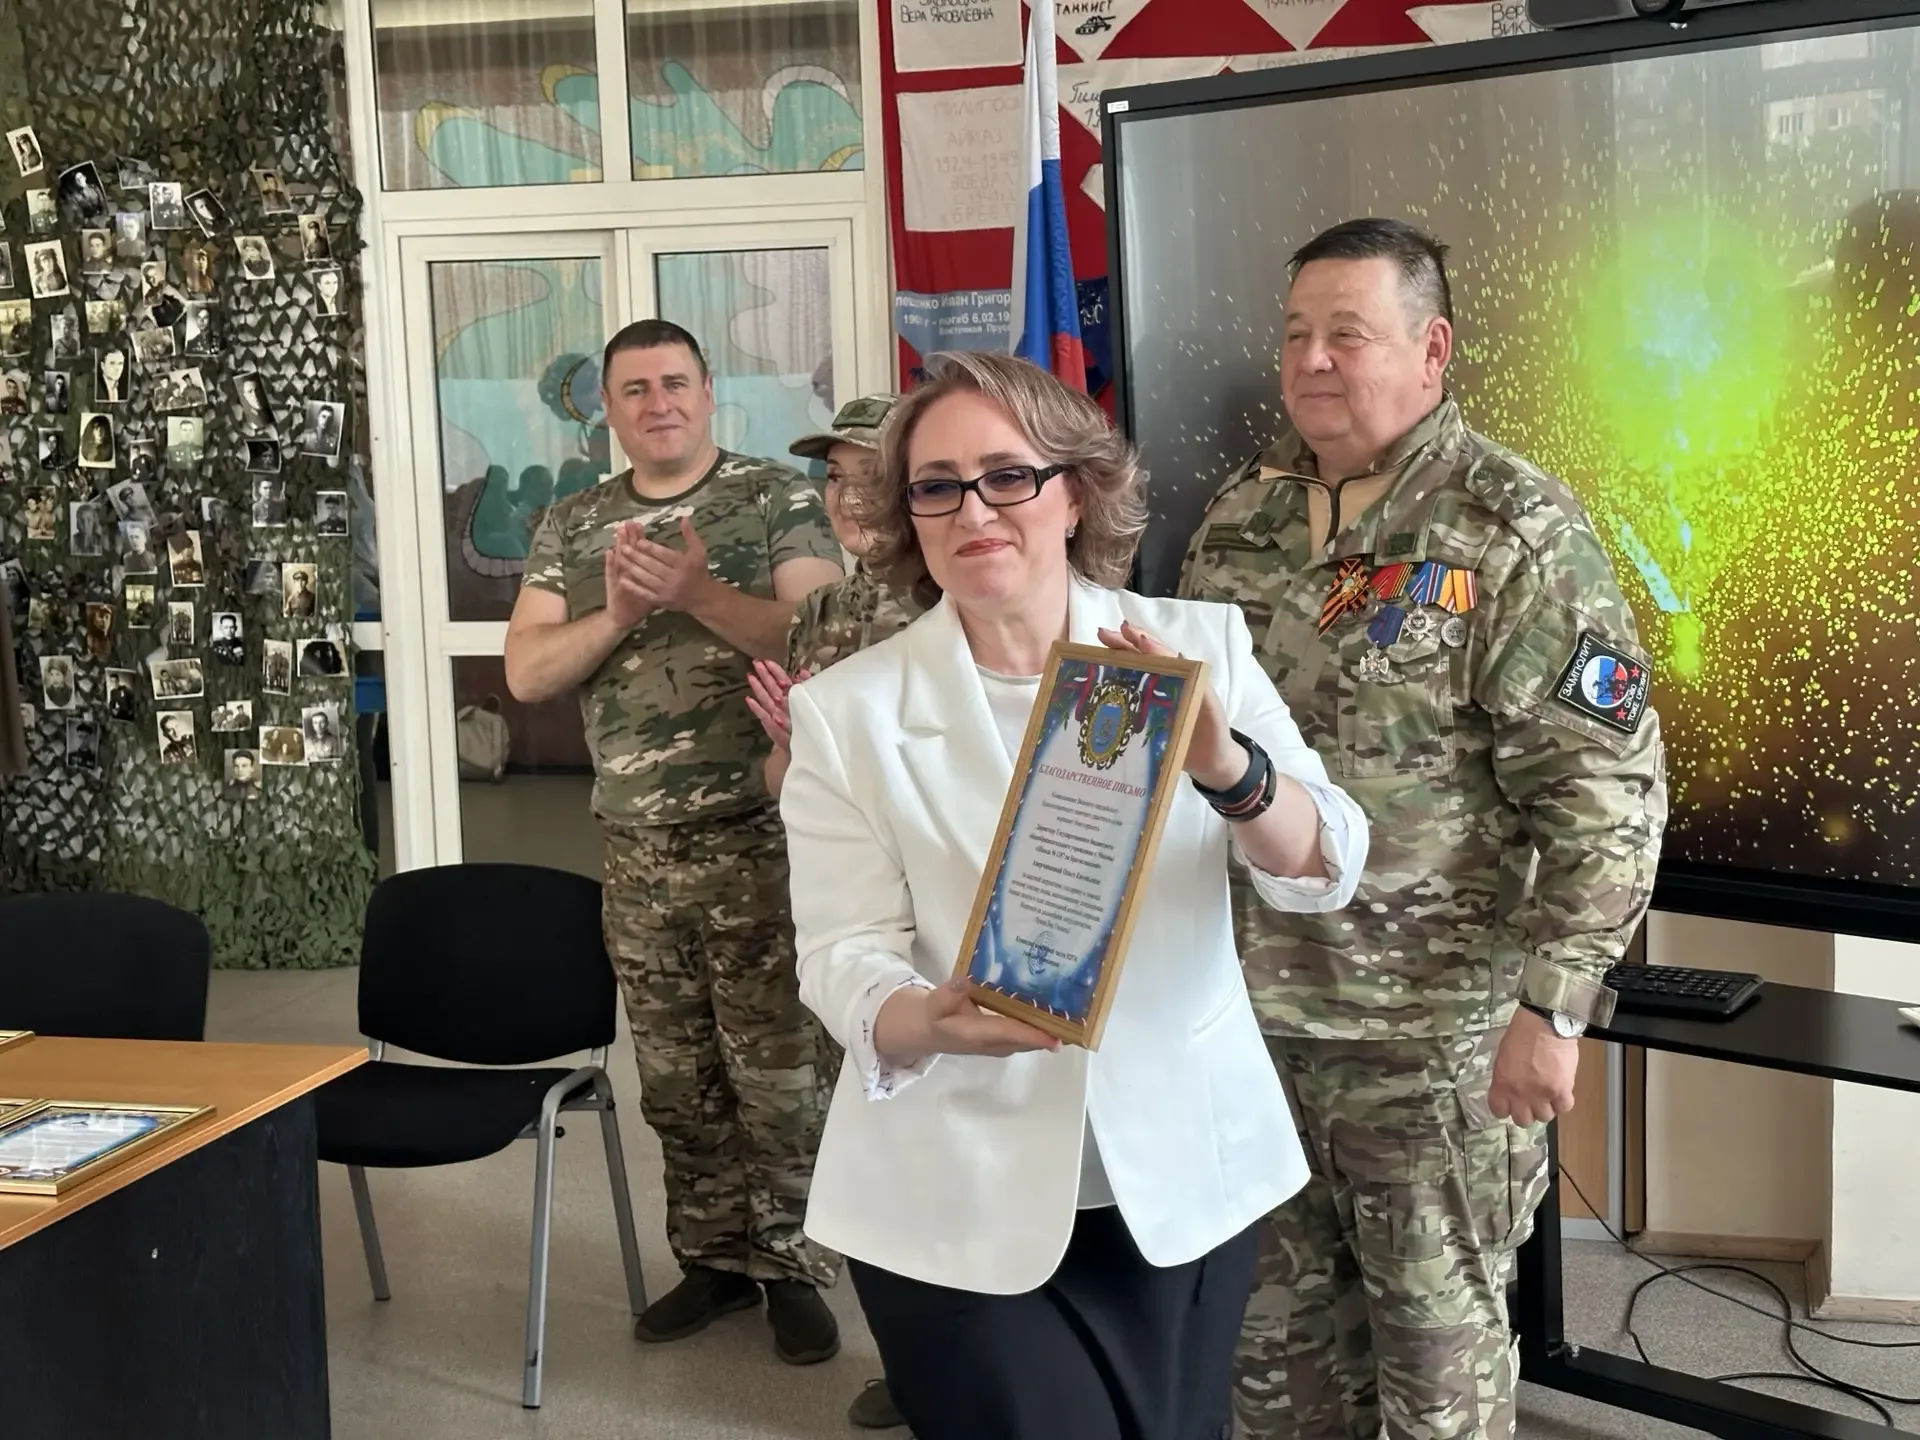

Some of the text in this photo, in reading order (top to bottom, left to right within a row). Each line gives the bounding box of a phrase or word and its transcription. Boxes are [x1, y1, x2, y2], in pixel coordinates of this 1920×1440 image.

[1562, 637, 1592, 697] ЗАМПОЛИТ
[1038, 763, 1147, 799] БЛАГОДАРСТВЕННОЕ ПИСЬМО
